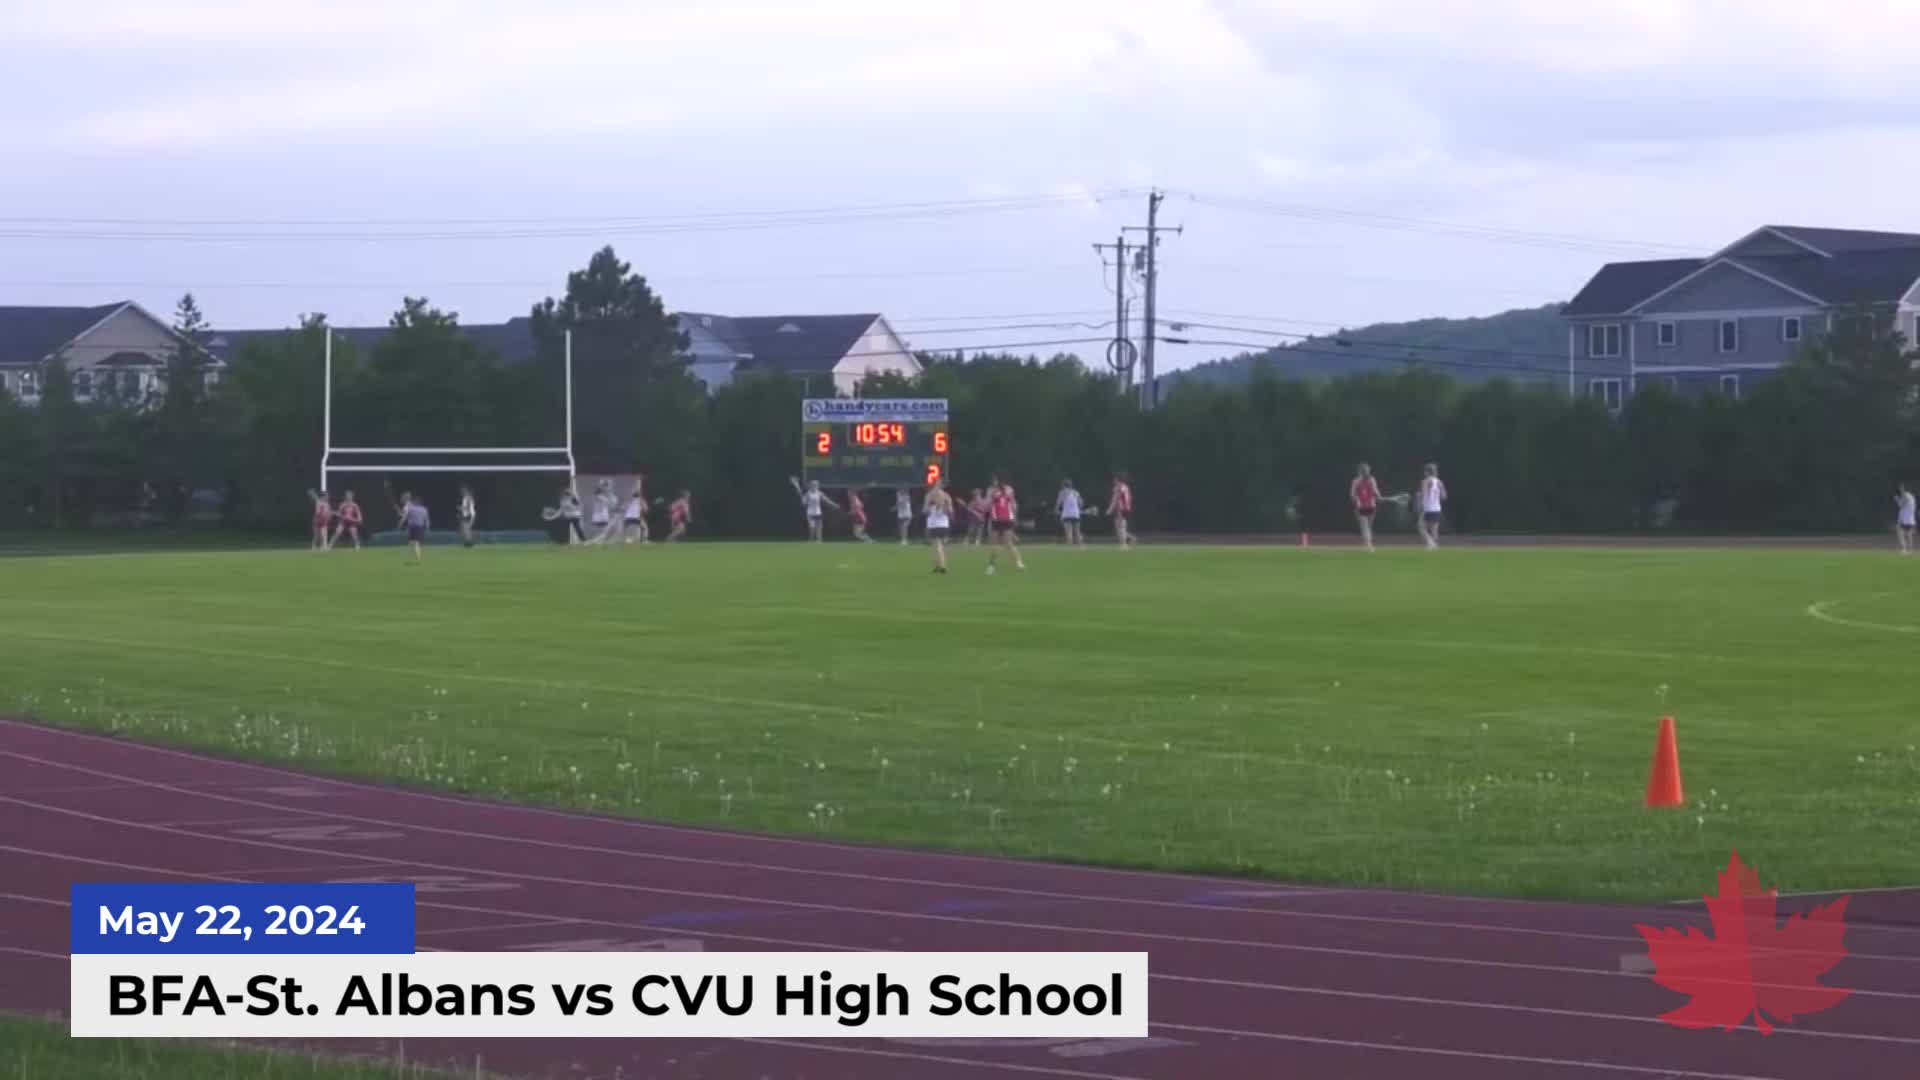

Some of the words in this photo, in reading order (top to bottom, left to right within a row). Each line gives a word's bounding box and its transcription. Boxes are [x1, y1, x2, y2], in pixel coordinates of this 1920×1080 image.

[817, 433, 831, 453] 2
[856, 423, 904, 444] 10:54
[934, 432, 947, 452] 6
